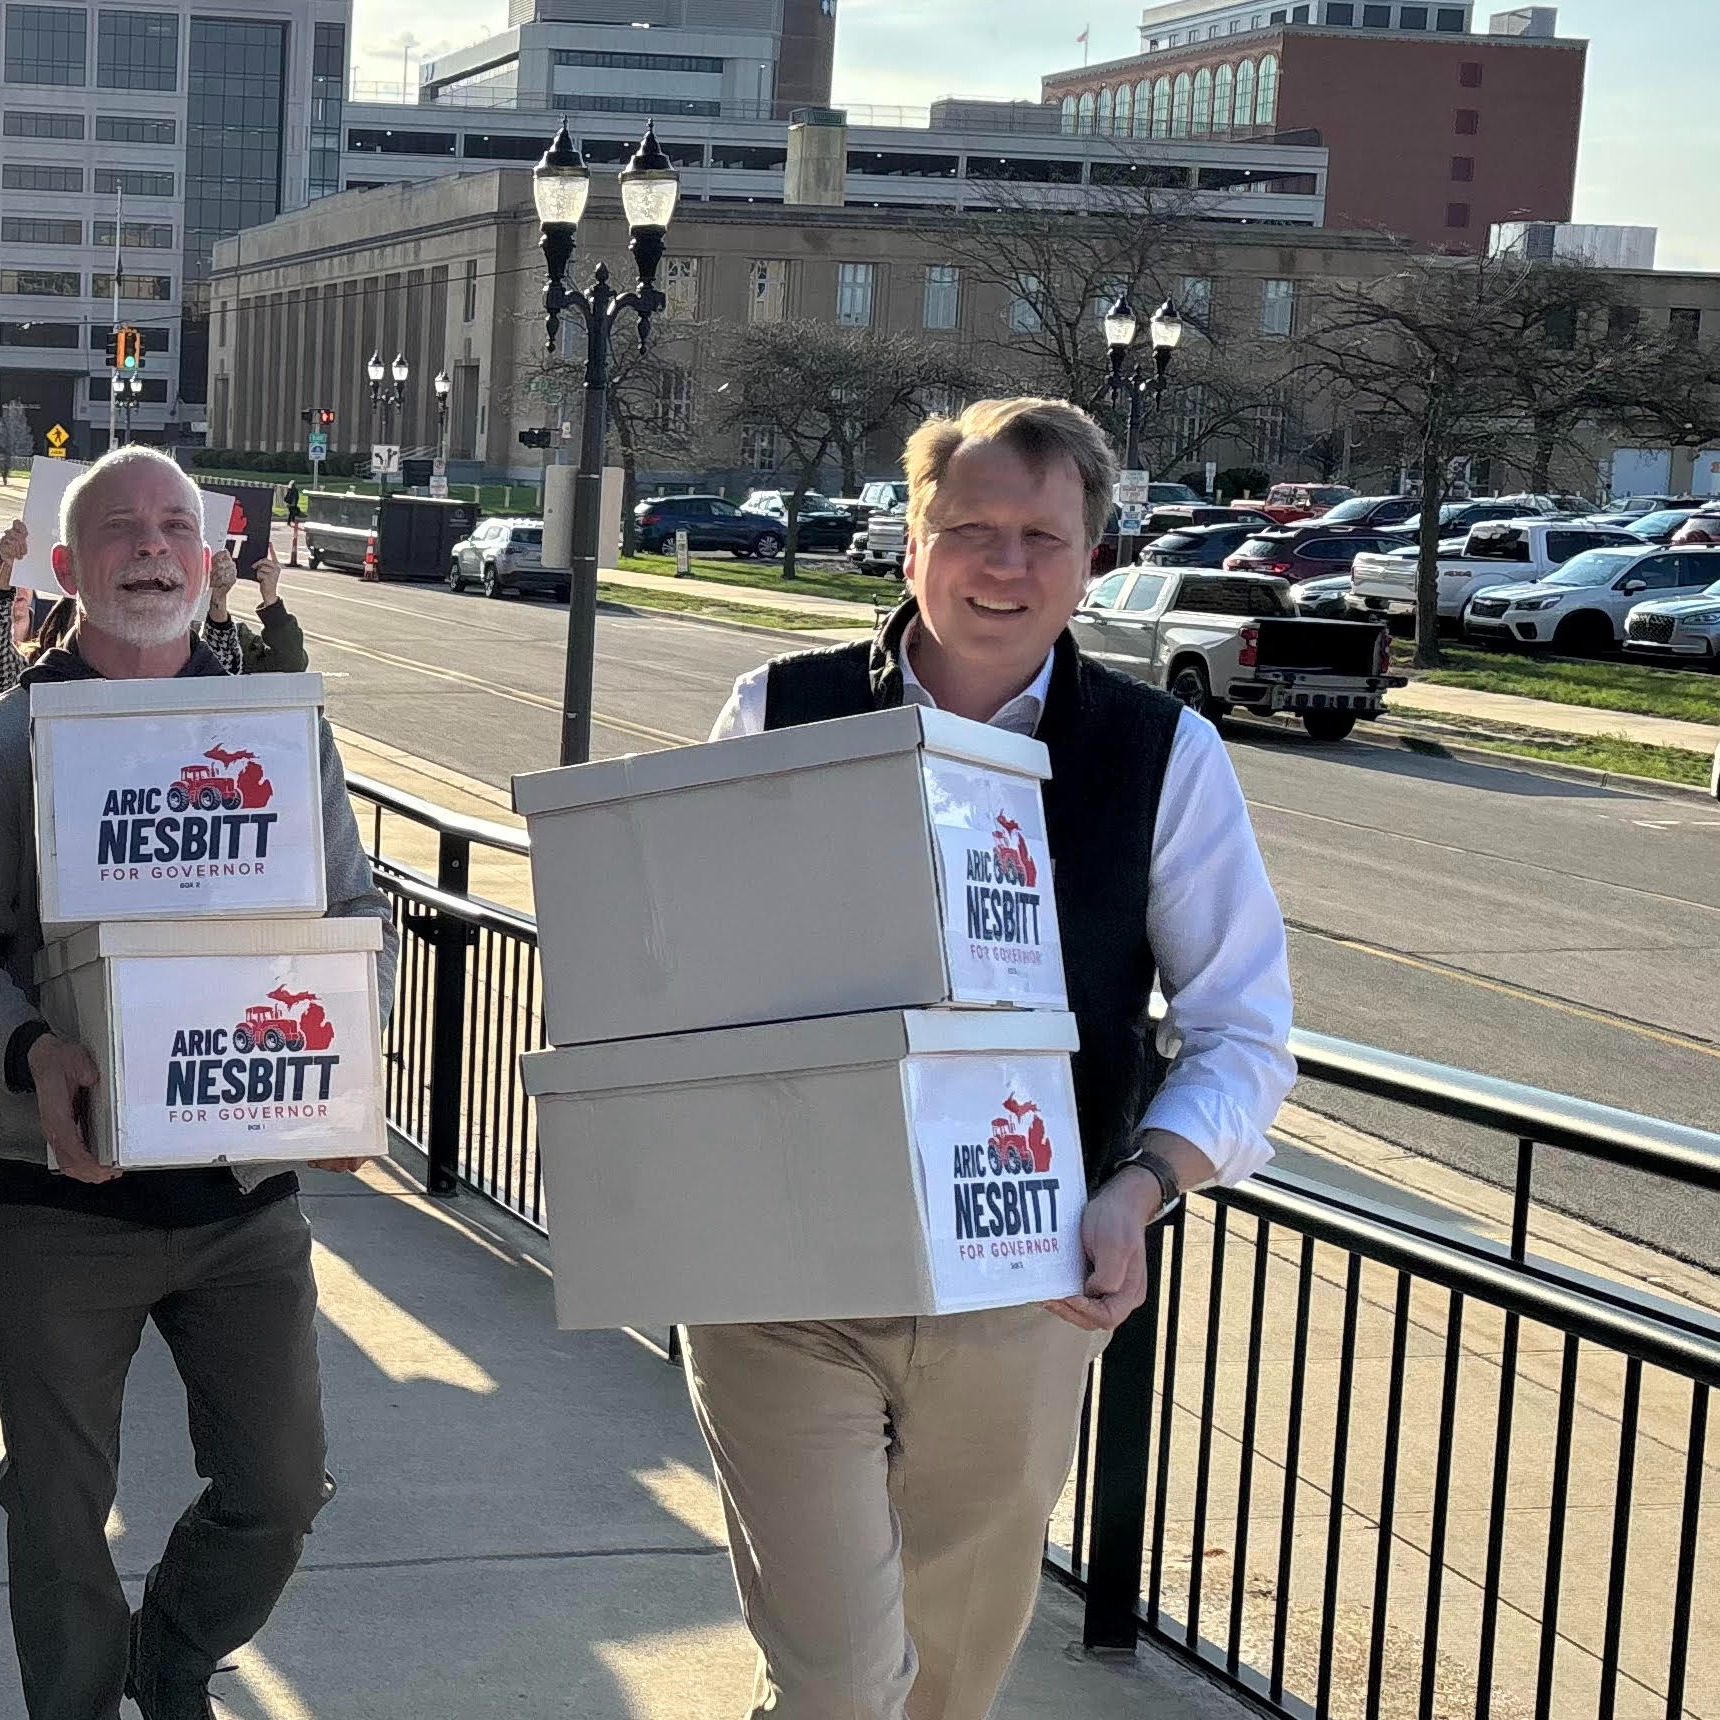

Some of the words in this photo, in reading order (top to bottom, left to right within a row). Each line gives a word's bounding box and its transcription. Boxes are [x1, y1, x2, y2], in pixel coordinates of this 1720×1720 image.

[102, 788, 162, 816] ARIC
[98, 813, 278, 865] NESBITT
[100, 865, 139, 881] FOR
[151, 862, 266, 879] GOVERNOR
[966, 848, 992, 883] ARIC
[967, 885, 1040, 945] NESBITT
[970, 944, 990, 960] FOR
[993, 944, 1041, 964] GOVERNOR
[171, 1029, 228, 1057] ARIC
[166, 1055, 340, 1106] NESBITT
[169, 1110, 208, 1123] FOR
[218, 1105, 328, 1120] GOVERNOR
[953, 1144, 986, 1178] ARIC
[954, 1178, 1060, 1240] NESBITT
[960, 1244, 984, 1260] FOR
[990, 1237, 1059, 1257] GOVERNOR
